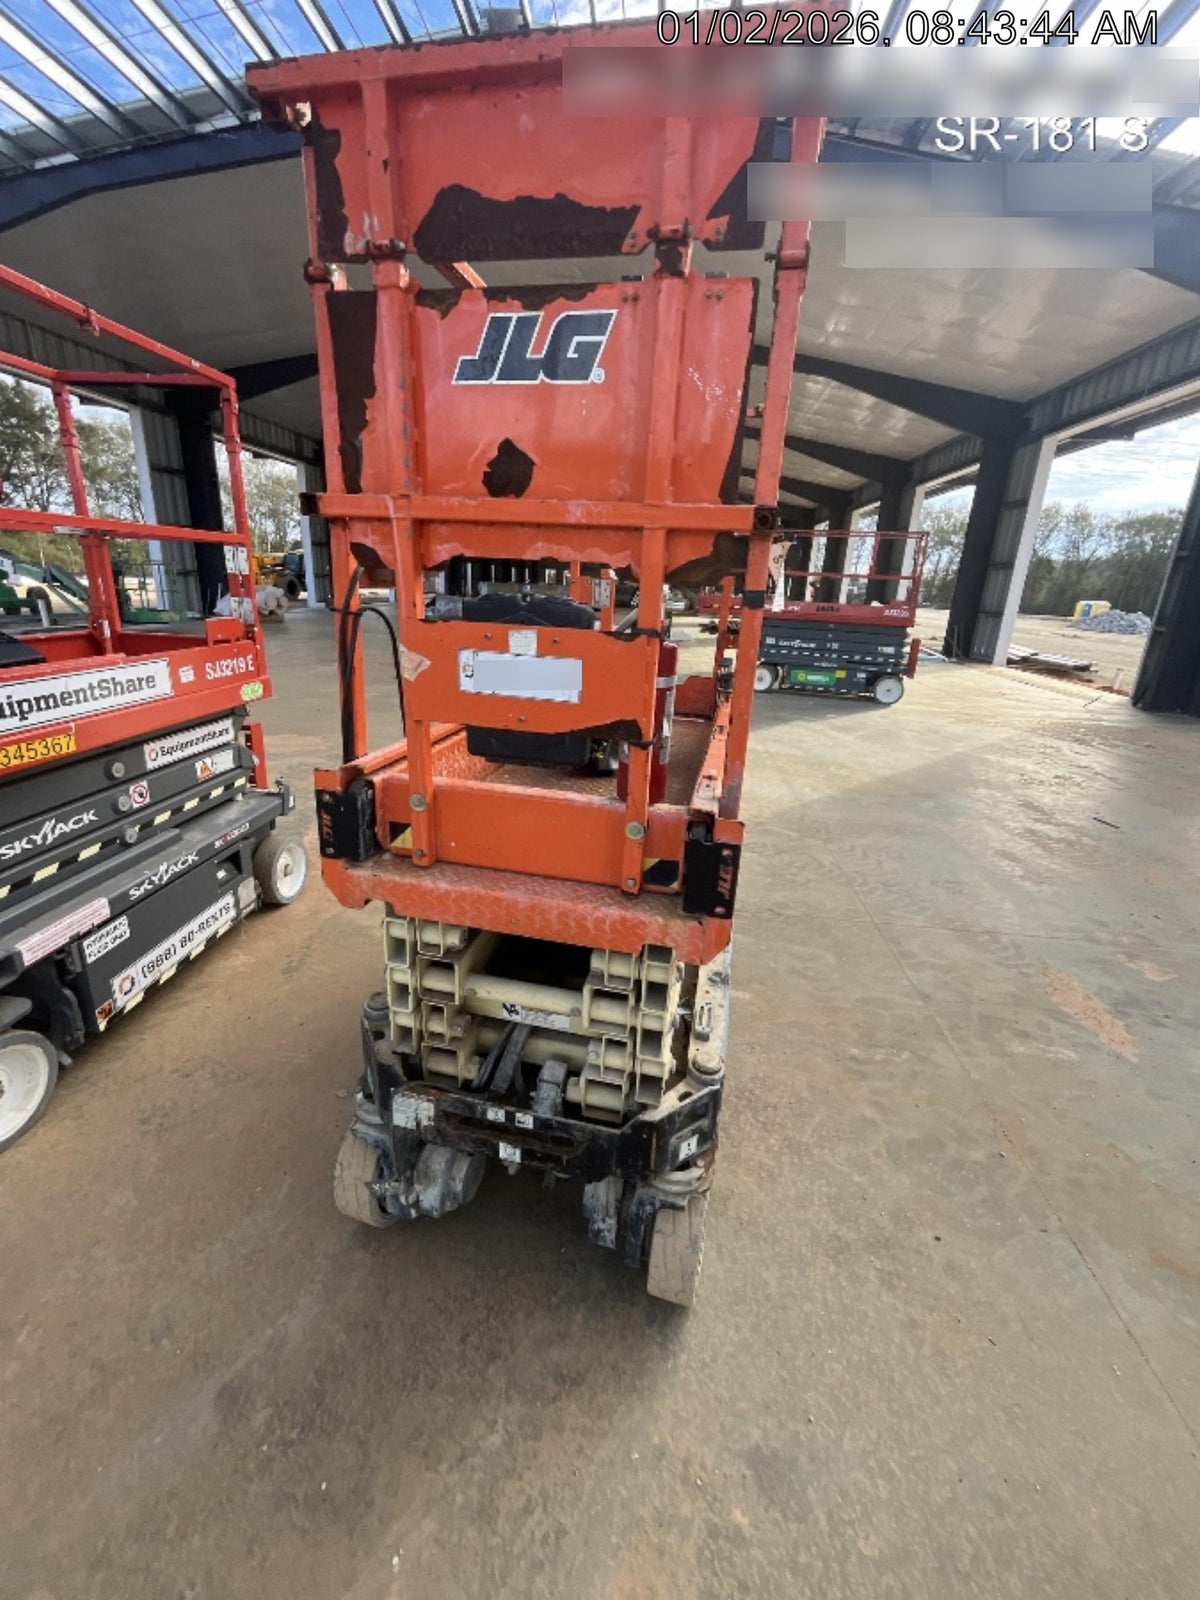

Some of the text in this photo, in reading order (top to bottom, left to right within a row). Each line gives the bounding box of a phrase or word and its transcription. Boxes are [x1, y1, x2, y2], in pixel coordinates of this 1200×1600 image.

[452, 309, 618, 385] JLG
[0, 808, 99, 860] SKYJACK
[129, 851, 200, 900] SKYJACK
